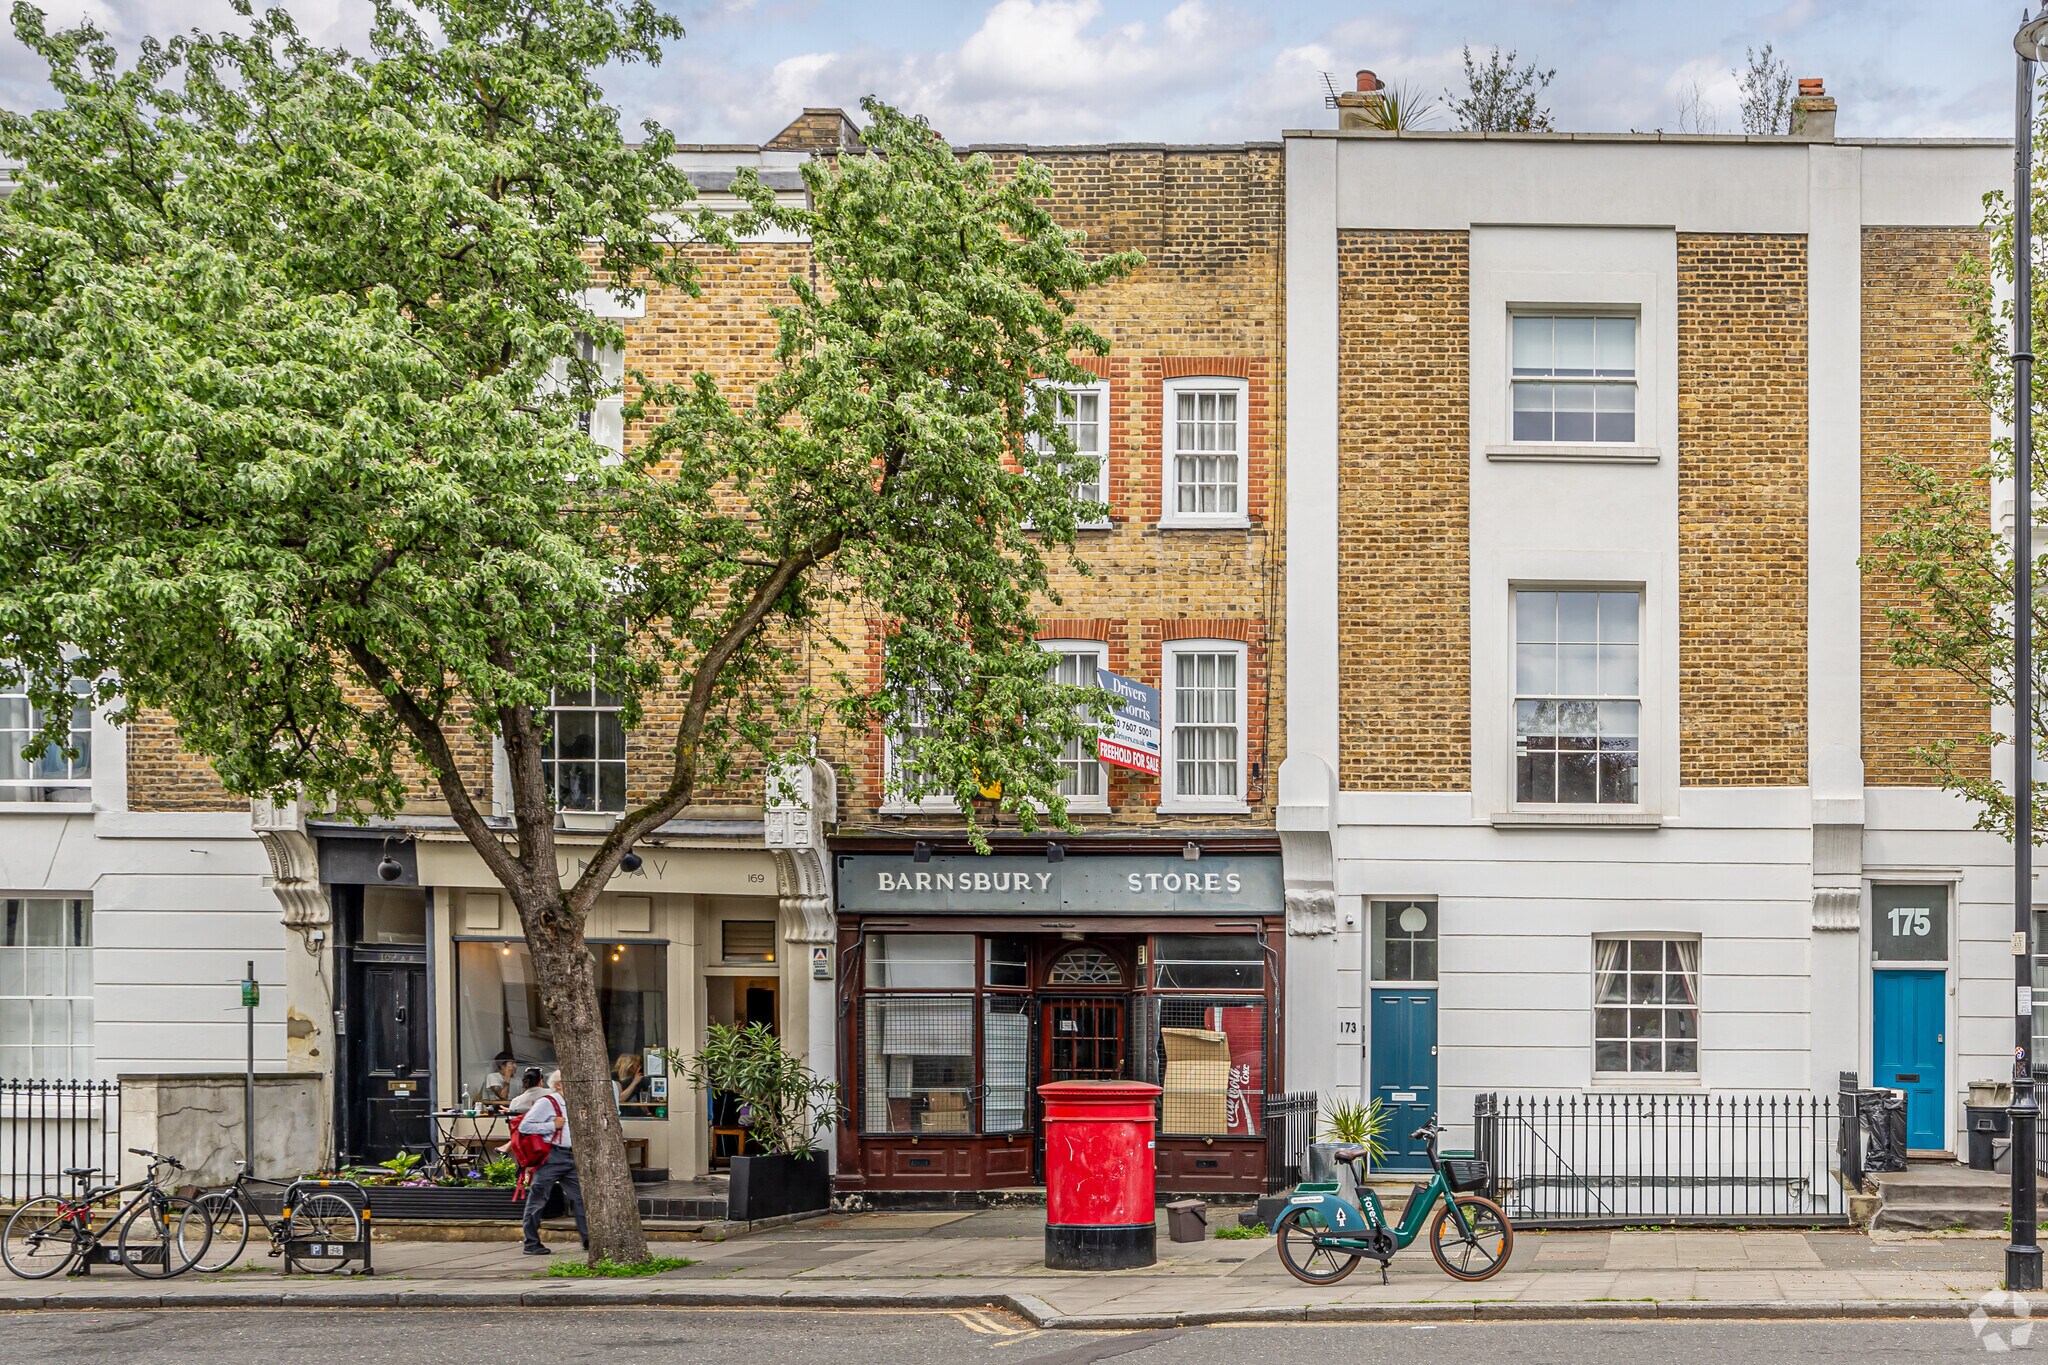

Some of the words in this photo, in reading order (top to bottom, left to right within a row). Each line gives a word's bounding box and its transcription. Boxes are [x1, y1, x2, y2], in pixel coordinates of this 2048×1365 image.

[1113, 678, 1147, 703] Drivers
[1122, 721, 1137, 733] 7607
[1138, 726, 1152, 738] 5001
[1100, 741, 1132, 764] FREEHOLD
[1132, 752, 1145, 768] FOR
[1146, 756, 1159, 773] SALE
[747, 873, 765, 883] 169
[877, 872, 1053, 892] BARNSBURY
[1128, 872, 1241, 893] STORES
[1887, 907, 1931, 937] 175
[1340, 1021, 1357, 1033] 173
